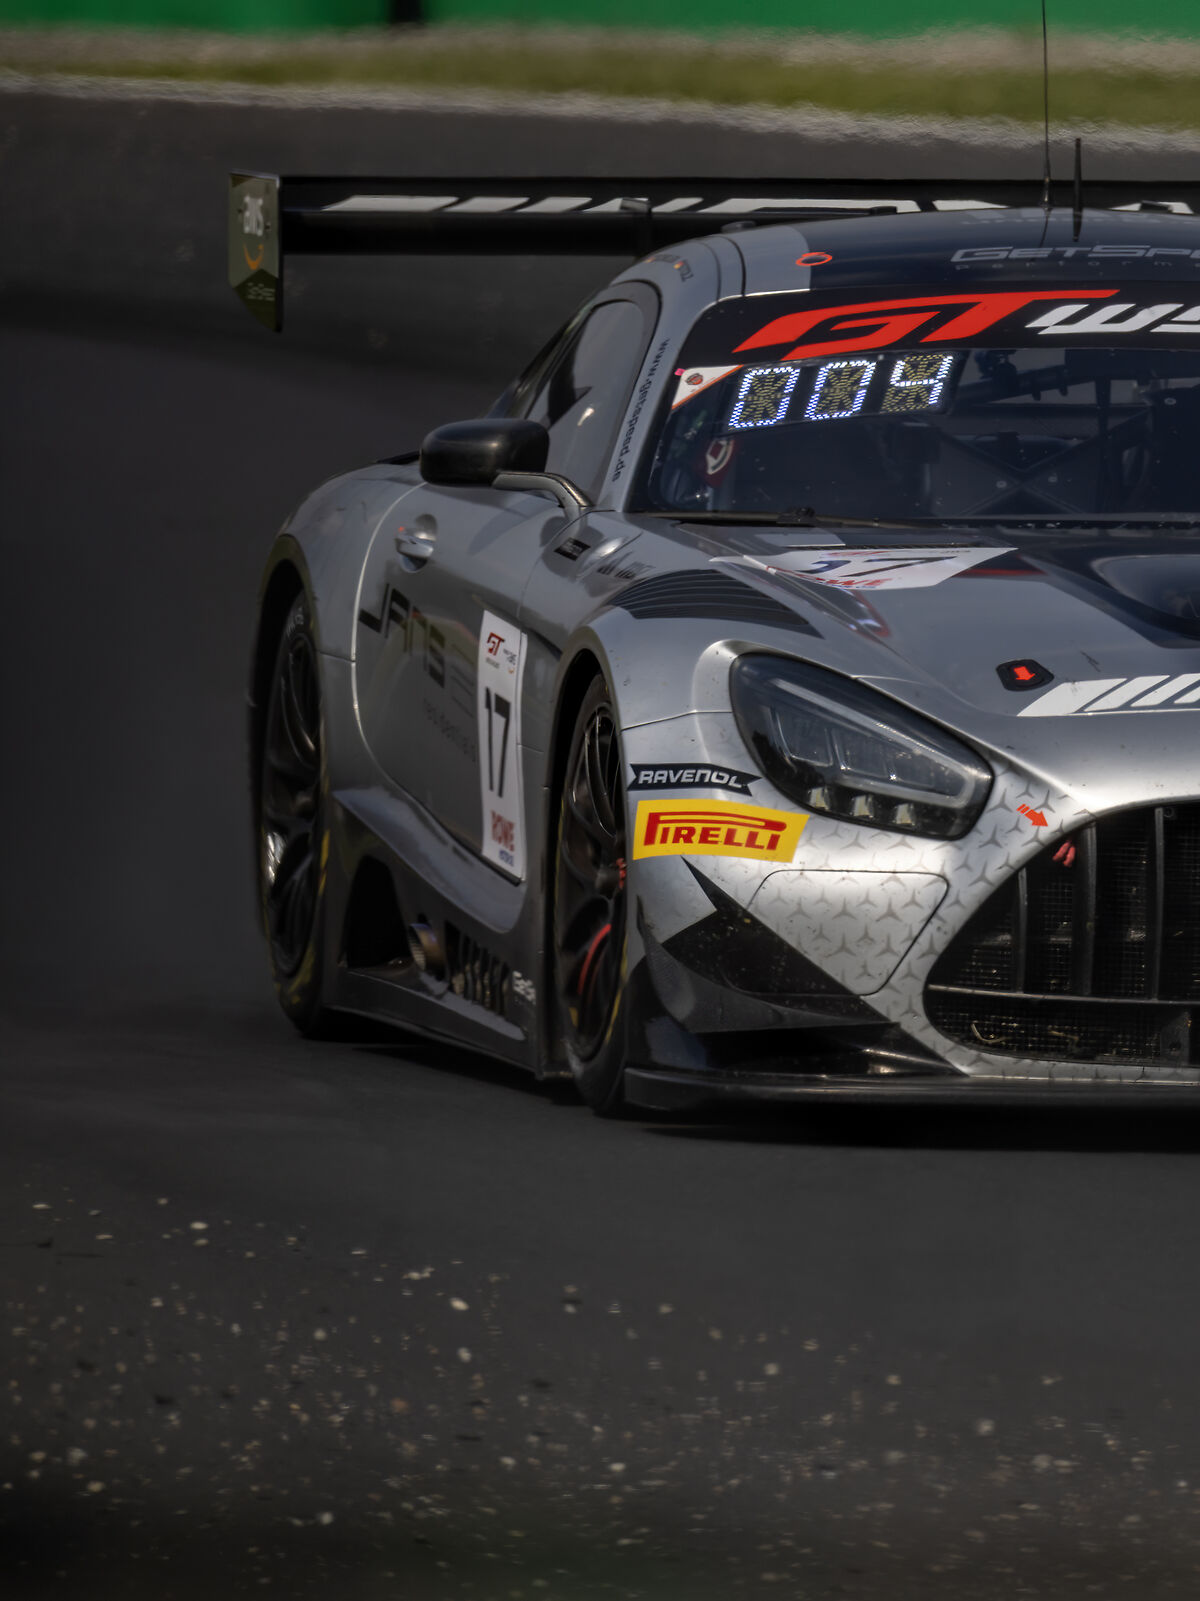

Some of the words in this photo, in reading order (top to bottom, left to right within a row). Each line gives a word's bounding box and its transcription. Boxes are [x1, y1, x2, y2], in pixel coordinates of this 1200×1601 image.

[732, 289, 1120, 361] GT
[485, 686, 511, 798] 17
[637, 768, 743, 789] RAVENOL
[643, 811, 787, 851] PIRELLI
